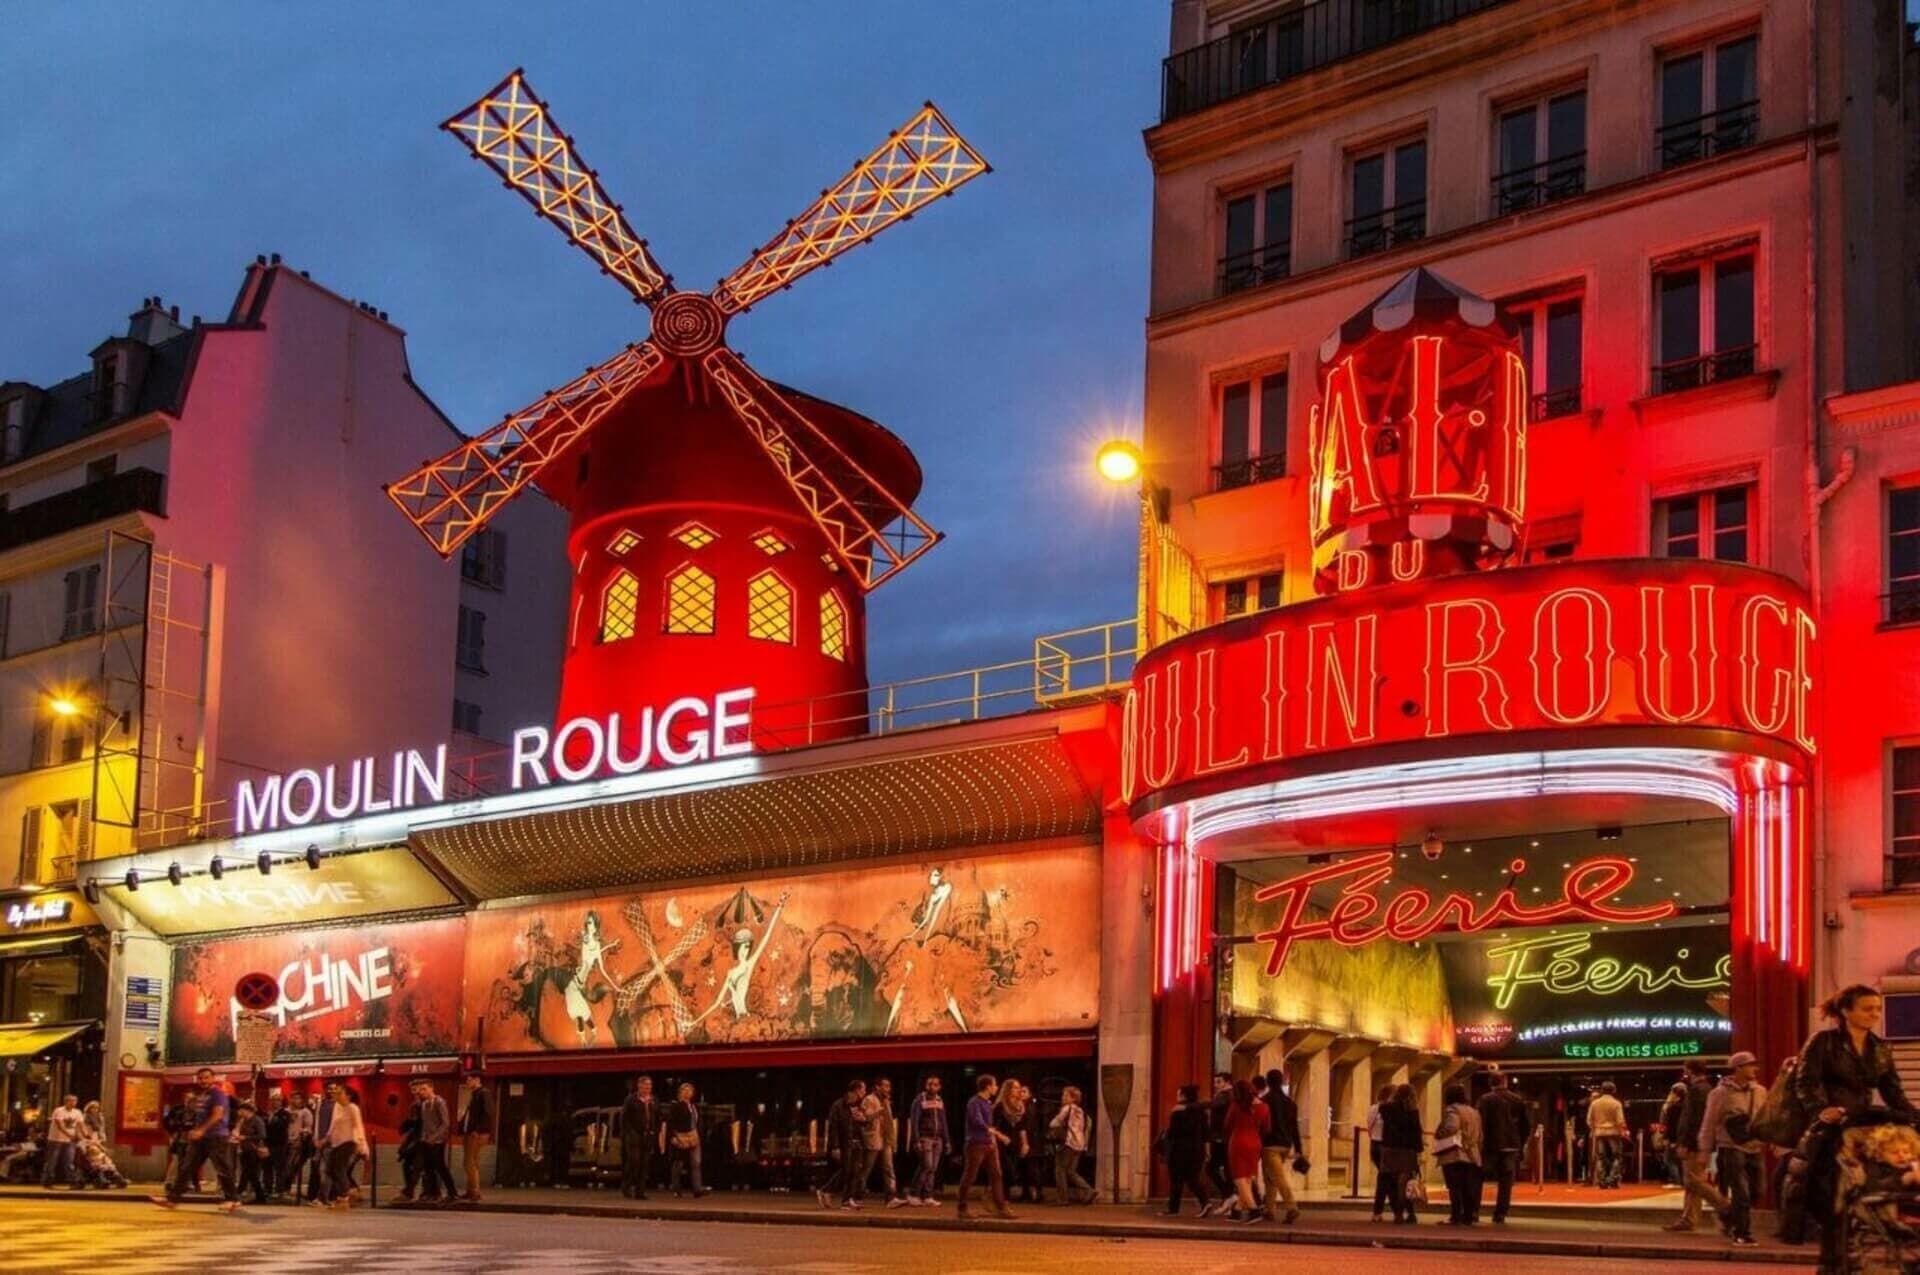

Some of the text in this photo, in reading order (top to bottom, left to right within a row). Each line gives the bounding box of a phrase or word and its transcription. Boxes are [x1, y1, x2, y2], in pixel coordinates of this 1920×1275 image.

[1338, 538, 1423, 591] DU
[1121, 584, 1817, 806] OULIN ROUGE
[234, 686, 756, 832] MOULIN ROUGE
[1255, 851, 1675, 977] Féerie
[230, 946, 393, 1042] CHINE
[1533, 1024, 1559, 1038] PLUS
[1650, 1018, 1672, 1029] CAN
[1563, 1041, 1699, 1057] LES DORISS GIRLS
